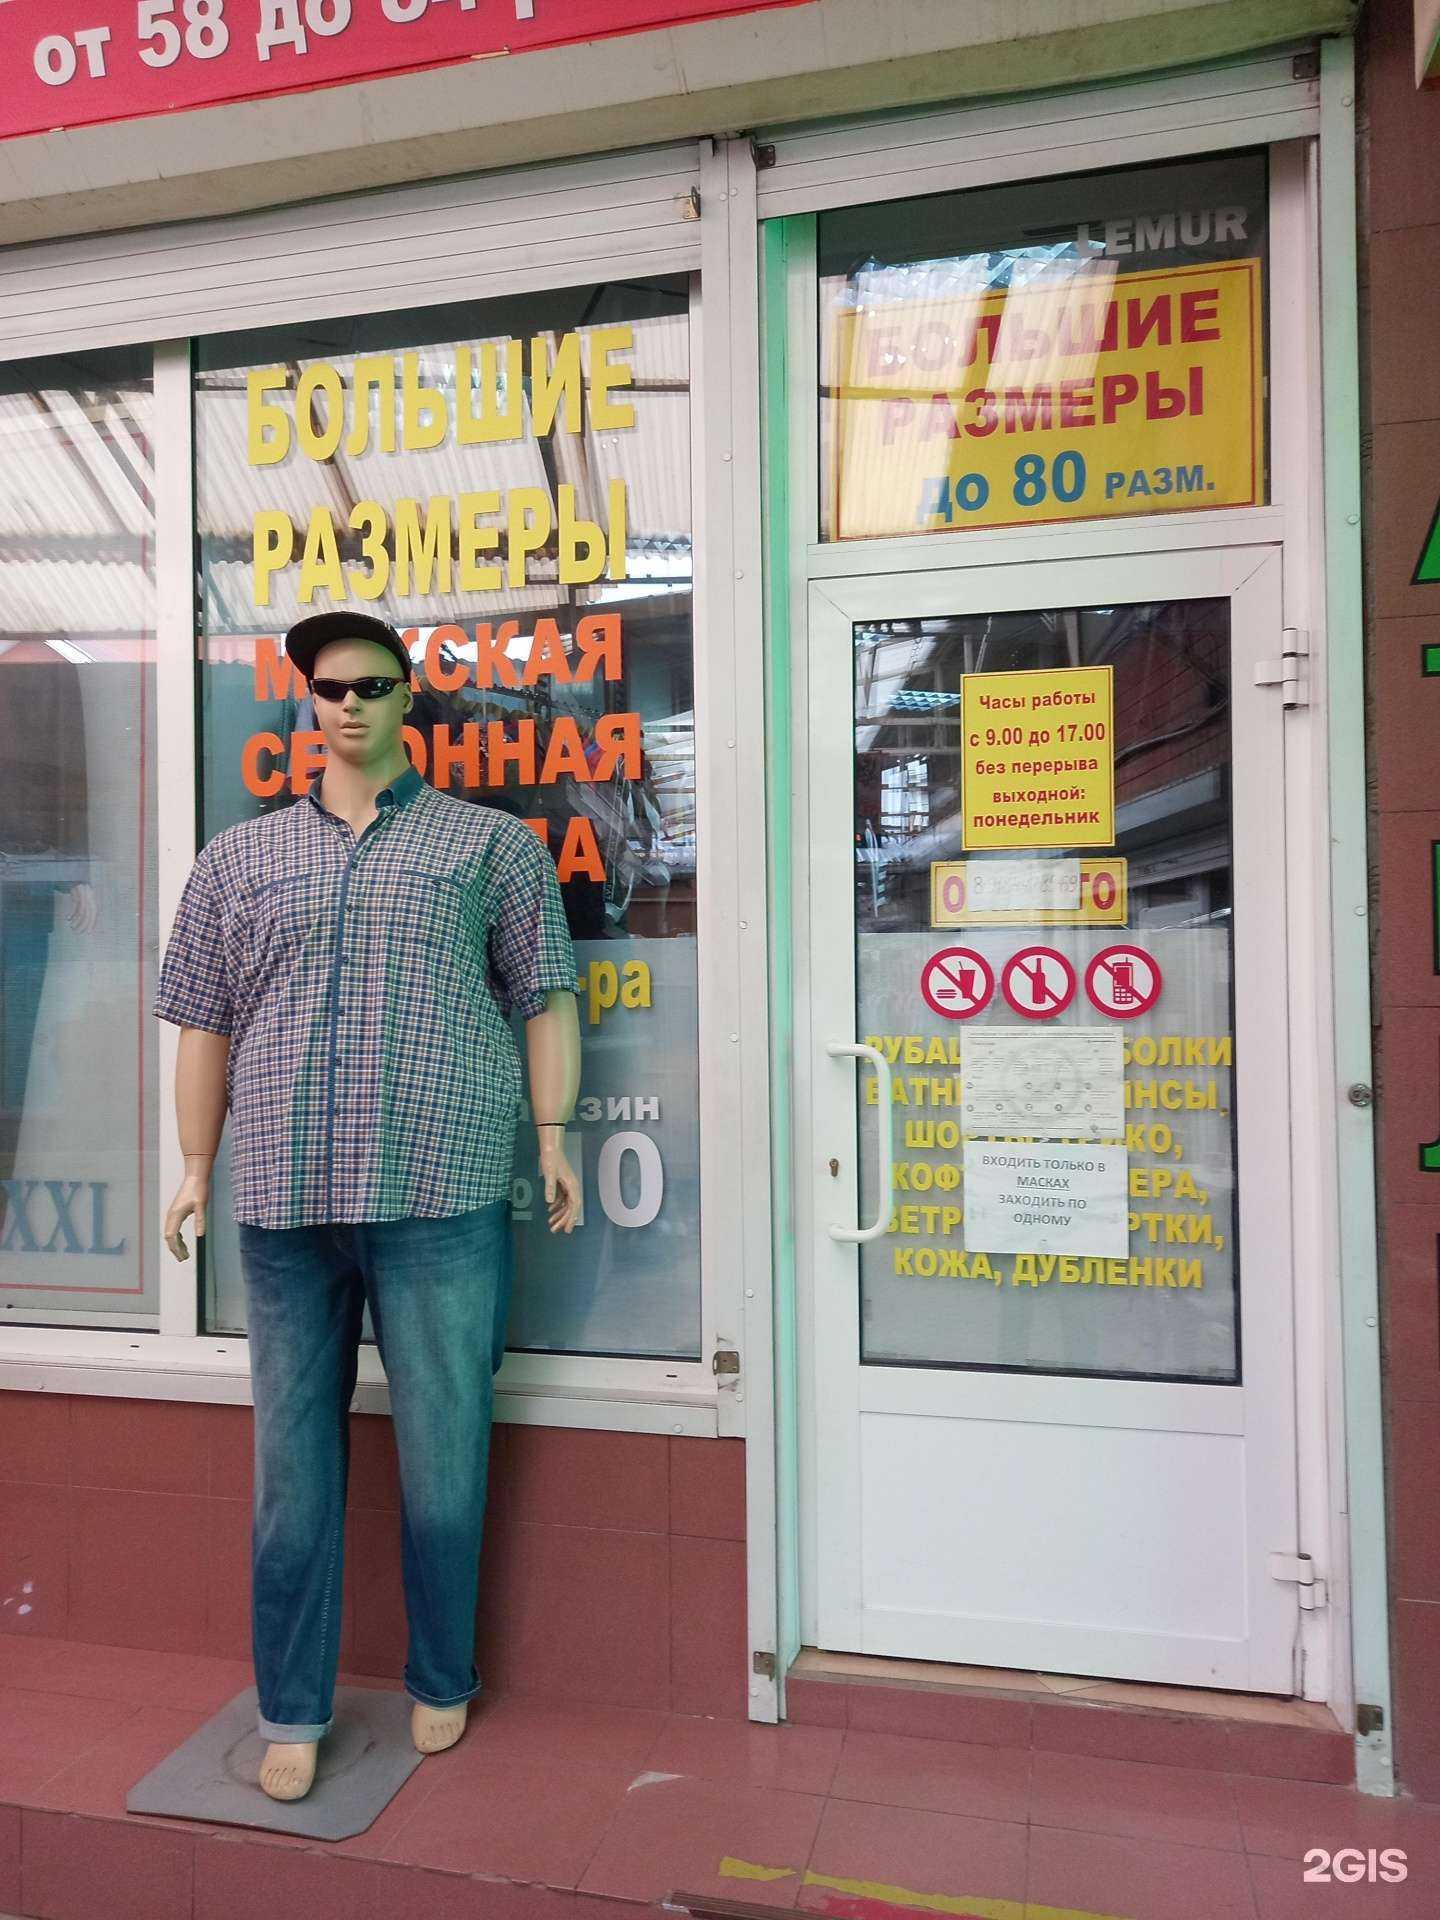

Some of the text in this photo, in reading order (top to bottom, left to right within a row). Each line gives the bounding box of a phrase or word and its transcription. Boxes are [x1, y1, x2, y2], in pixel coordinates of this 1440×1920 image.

[33, 0, 352, 86] от 58 до
[1076, 205, 1249, 258] LEMUR
[866, 288, 1223, 378] БОЛЬШИЕ
[247, 326, 636, 467] БОЛЬШИЕ
[881, 366, 1205, 446] РАЗМЕРЫ
[1013, 450, 1088, 507] 80
[1105, 464, 1216, 499] РАЗМ.
[253, 478, 627, 606] РАЗМЕРЫ
[253, 613, 624, 701] МСКАЯ
[979, 691, 1096, 711] Часы работы
[970, 722, 1106, 747] с 9.00 до 17.00
[976, 758, 1099, 777] без перерыва
[993, 786, 1086, 804] выходной:
[973, 809, 1100, 829] понедельник
[890, 1161, 1209, 1206] КОФ ЕРА,
[982, 1155, 1106, 1172] ВХОДИТЬ ТОЛЬКО В
[1016, 1176, 1071, 1189] МАСКАХ
[999, 1194, 1087, 1210] ЗАХОДИТЬ ПО
[1013, 1213, 1072, 1226] ОДНОМУ
[893, 1247, 1203, 1289] КОЖА, ДУБЛЕНКИ
